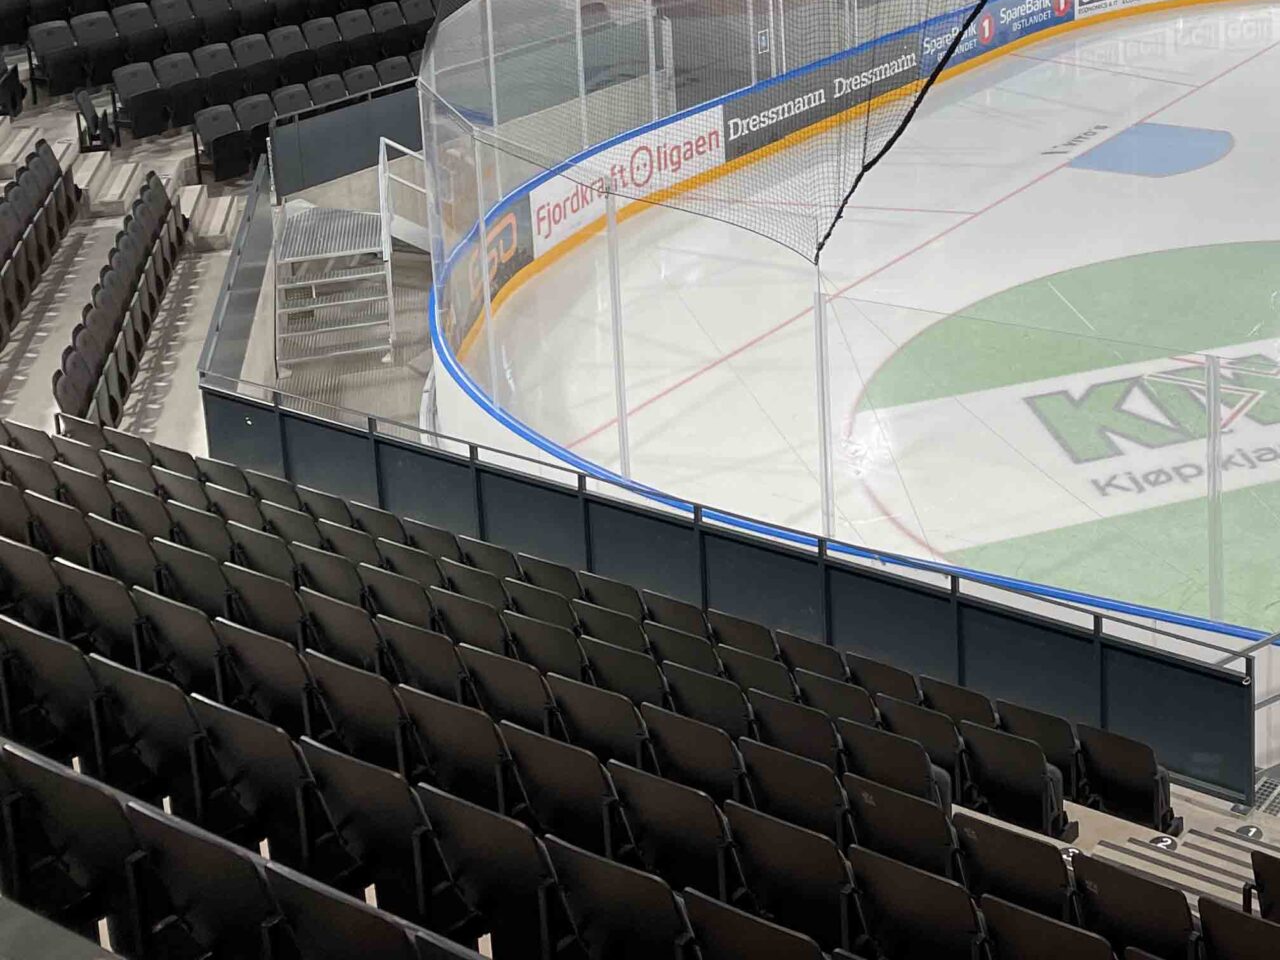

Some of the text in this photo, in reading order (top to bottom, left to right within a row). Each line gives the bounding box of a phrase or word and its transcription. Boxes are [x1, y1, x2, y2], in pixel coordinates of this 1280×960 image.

[923, 23, 977, 55] SpareBnk
[833, 52, 917, 99] Dressmann
[727, 88, 826, 140] Dressmann
[1091, 462, 1204, 497] Kjøp
[1157, 837, 1172, 850] 2
[1248, 827, 1257, 837] 1
